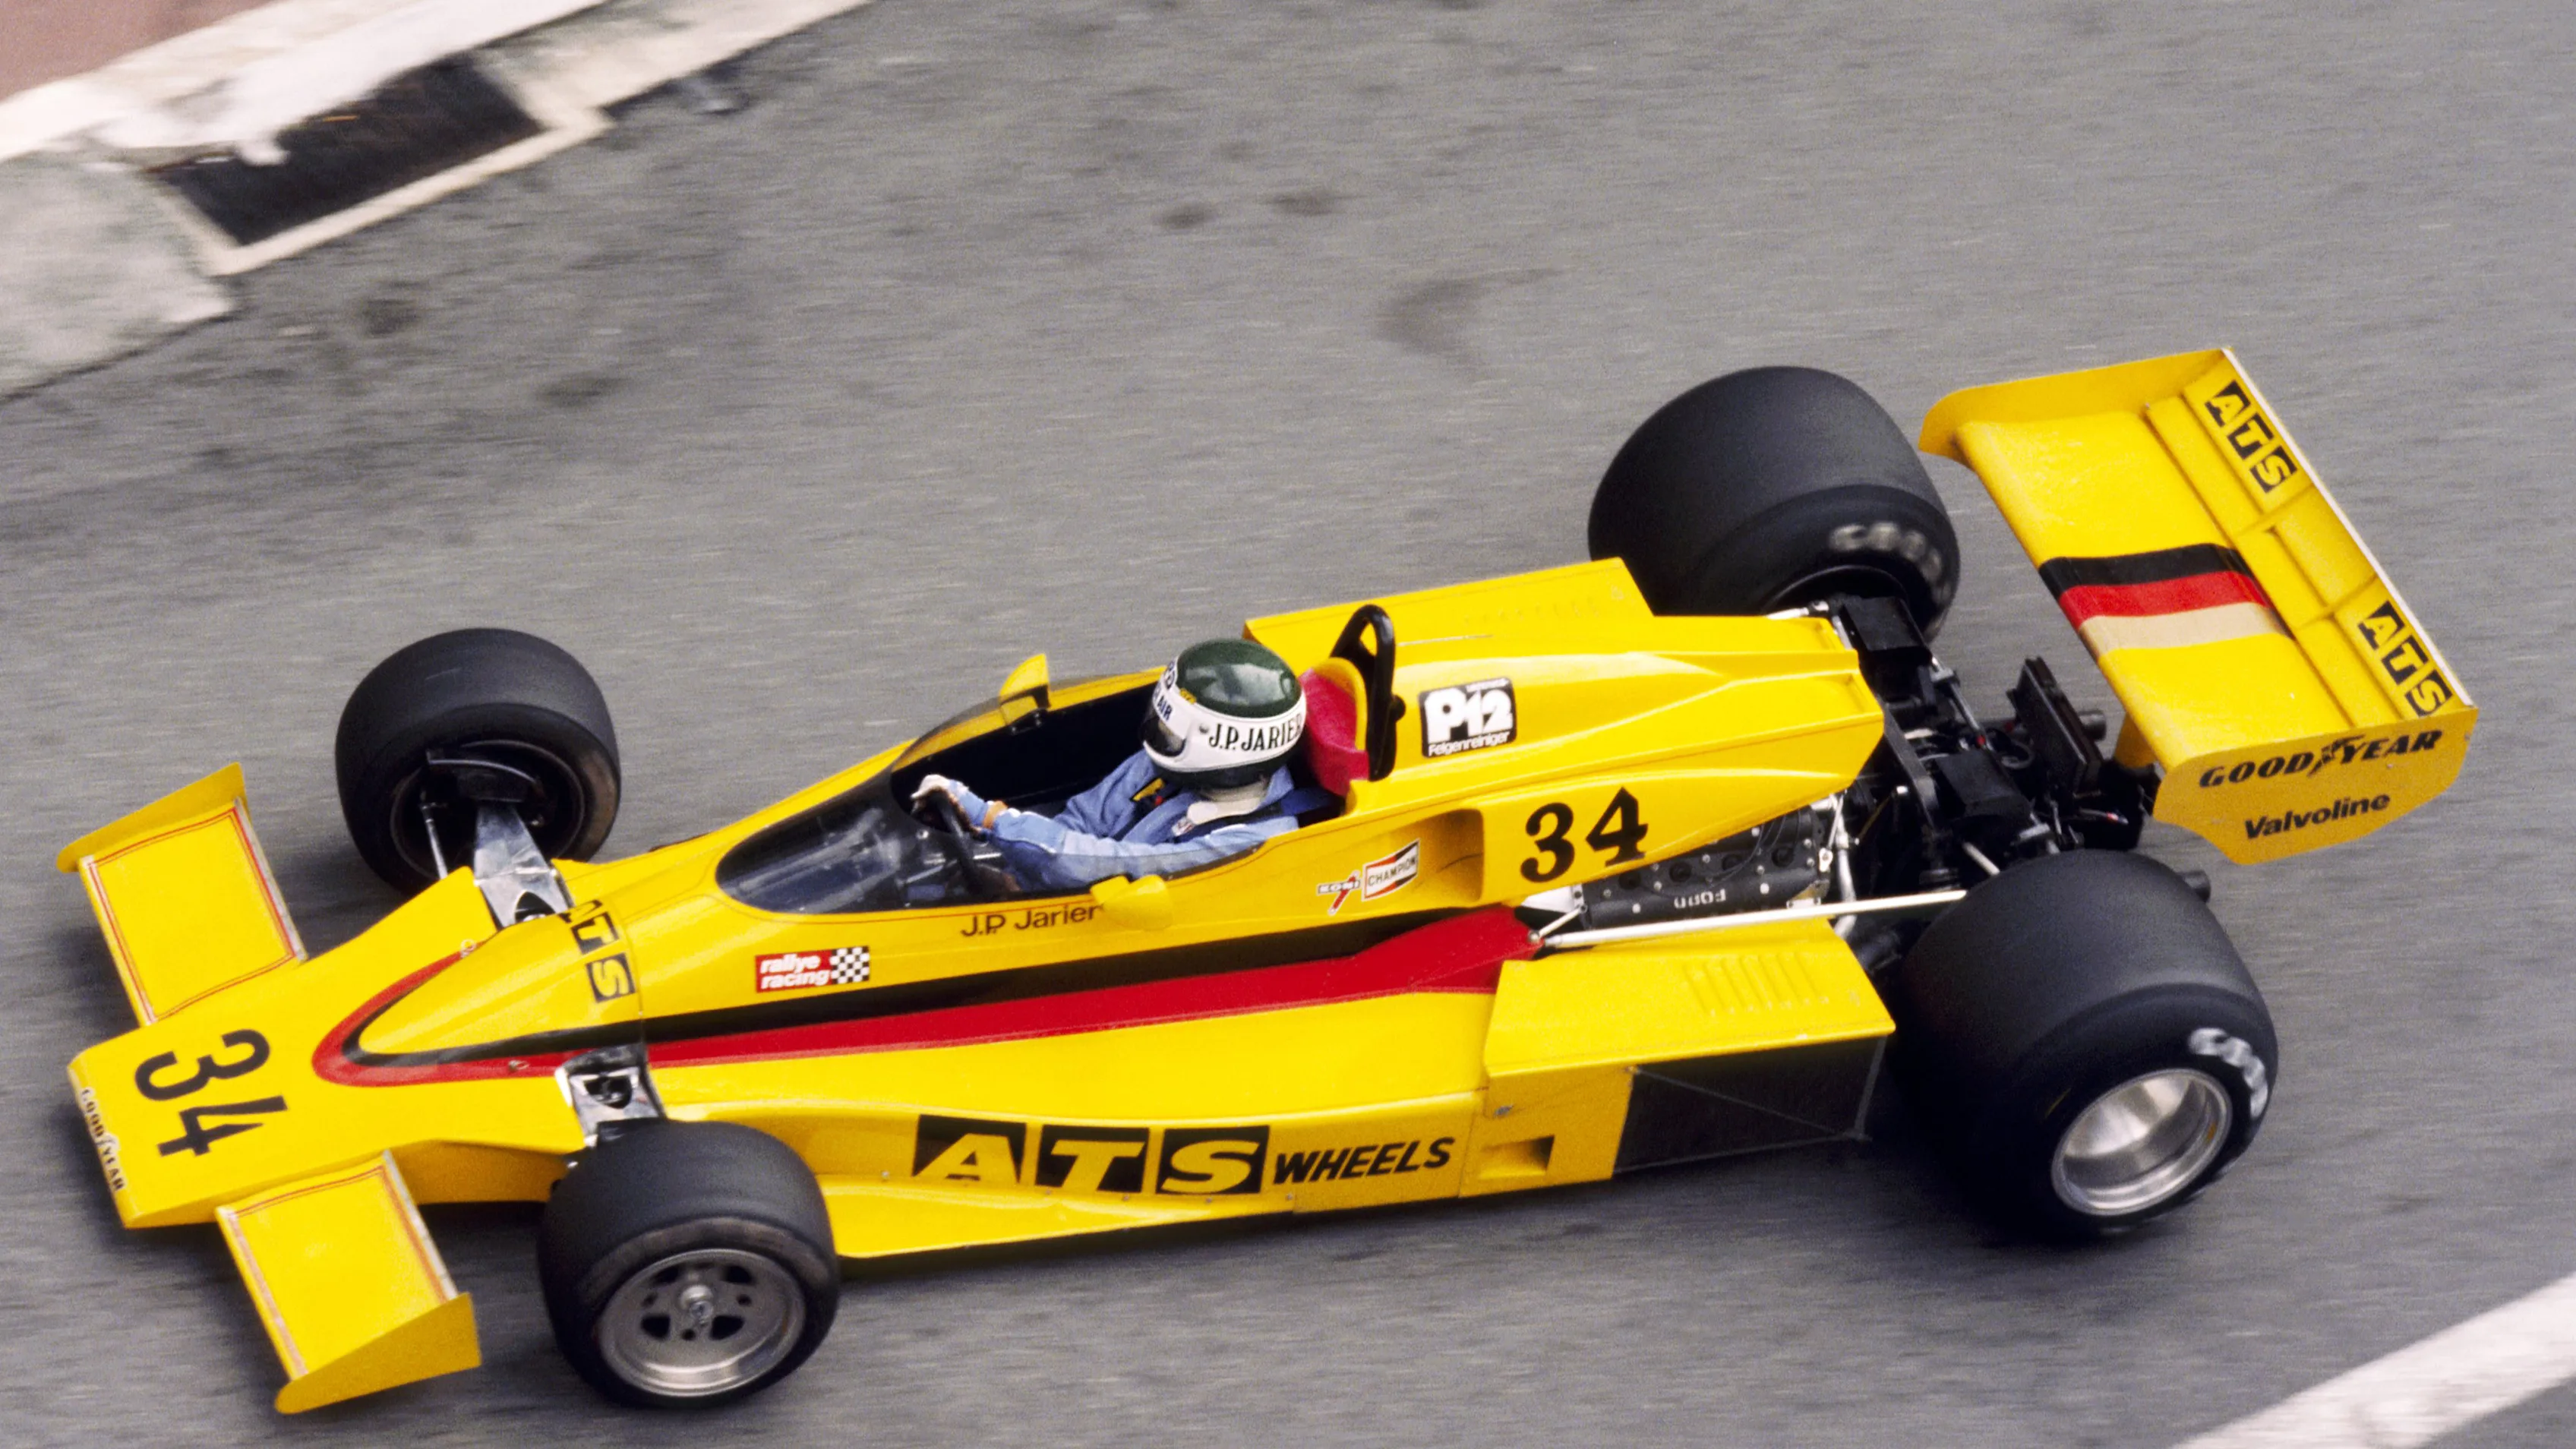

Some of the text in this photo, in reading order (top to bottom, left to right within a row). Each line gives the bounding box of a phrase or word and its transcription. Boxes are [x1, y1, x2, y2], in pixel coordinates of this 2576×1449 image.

[2205, 381, 2297, 492] ATS
[2358, 601, 2451, 716] ATS
[1519, 787, 1649, 884] 34
[2245, 794, 2391, 840] Valvoline
[1368, 856, 1417, 886] CHAMPION
[1014, 904, 1104, 930] Jarier
[760, 953, 821, 974] rallye
[760, 969, 831, 990] racing
[134, 1030, 288, 1157] 34
[914, 1125, 1456, 1194] ATS WHEELS
